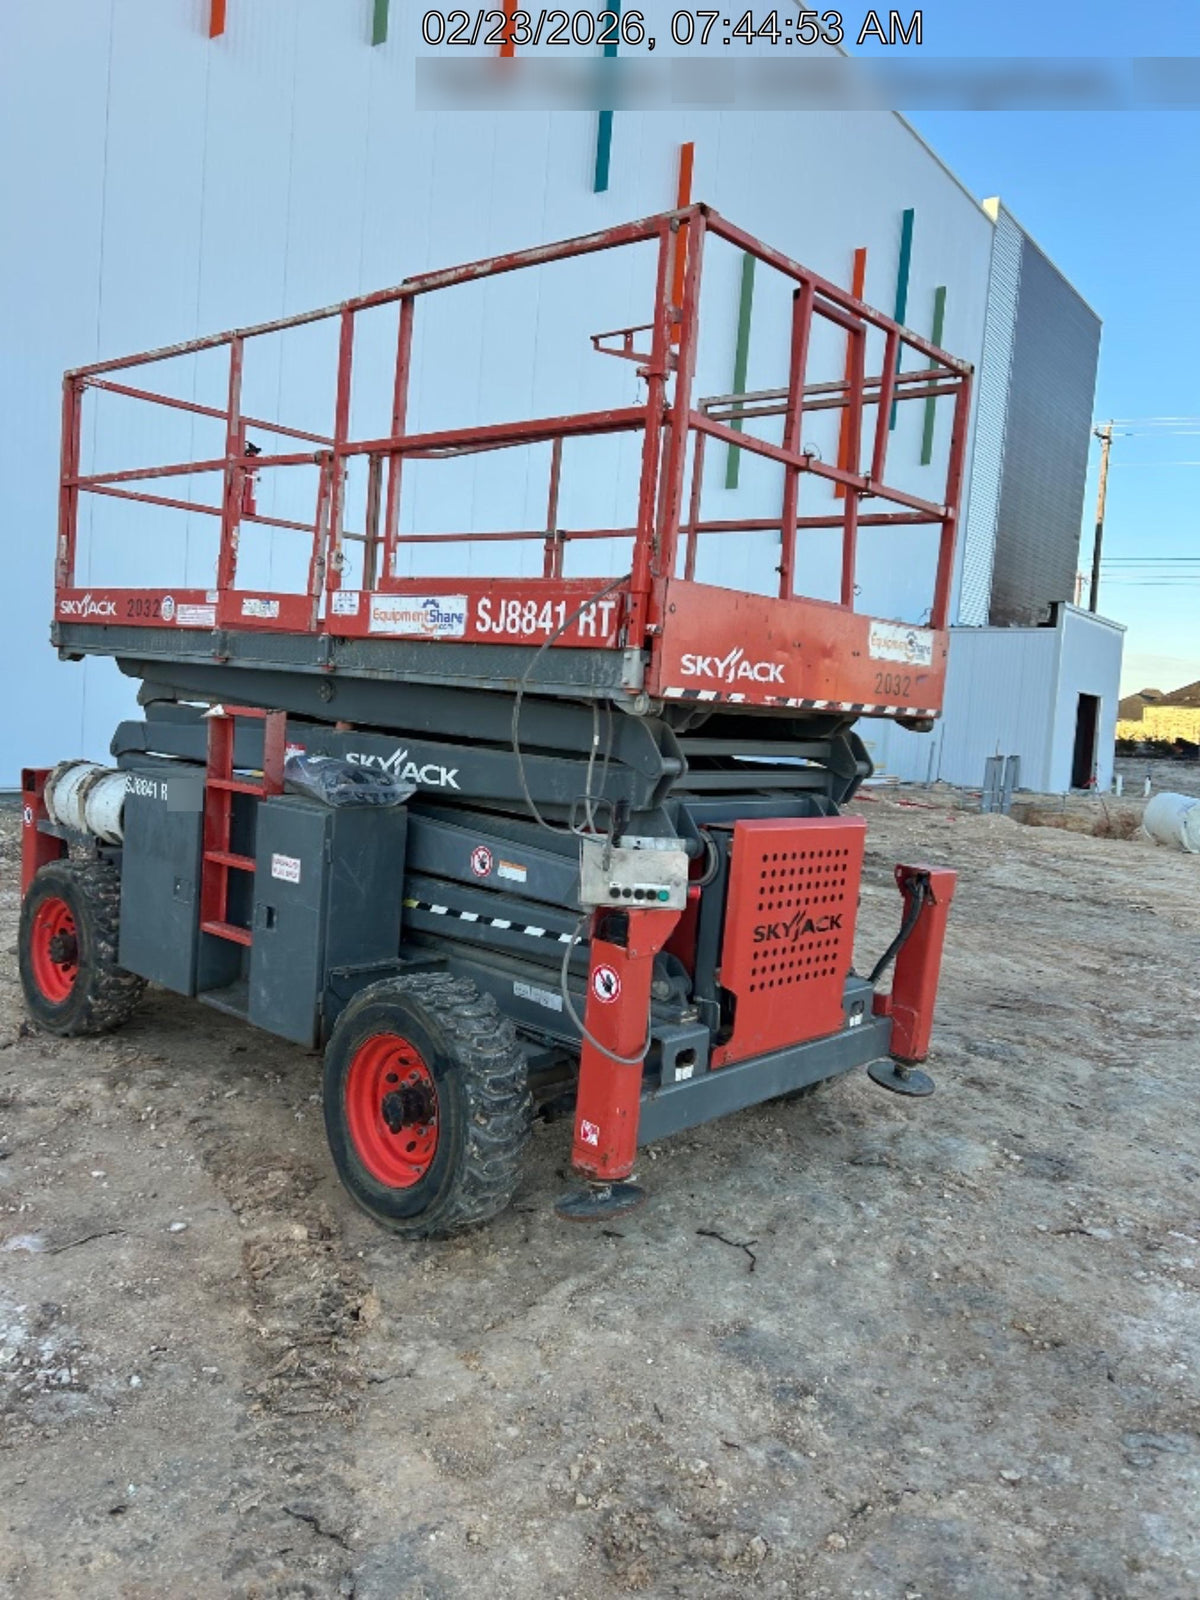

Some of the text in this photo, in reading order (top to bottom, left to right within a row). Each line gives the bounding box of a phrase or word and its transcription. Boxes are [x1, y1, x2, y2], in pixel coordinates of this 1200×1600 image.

[60, 593, 117, 617] SKYJACK
[127, 598, 160, 618] 2032
[373, 607, 464, 624] EquipmentShare
[475, 597, 616, 637] SJ8841 RT
[680, 645, 785, 684] SKYJACK
[874, 672, 911, 698] 2032
[753, 910, 843, 943] SKYJACK
